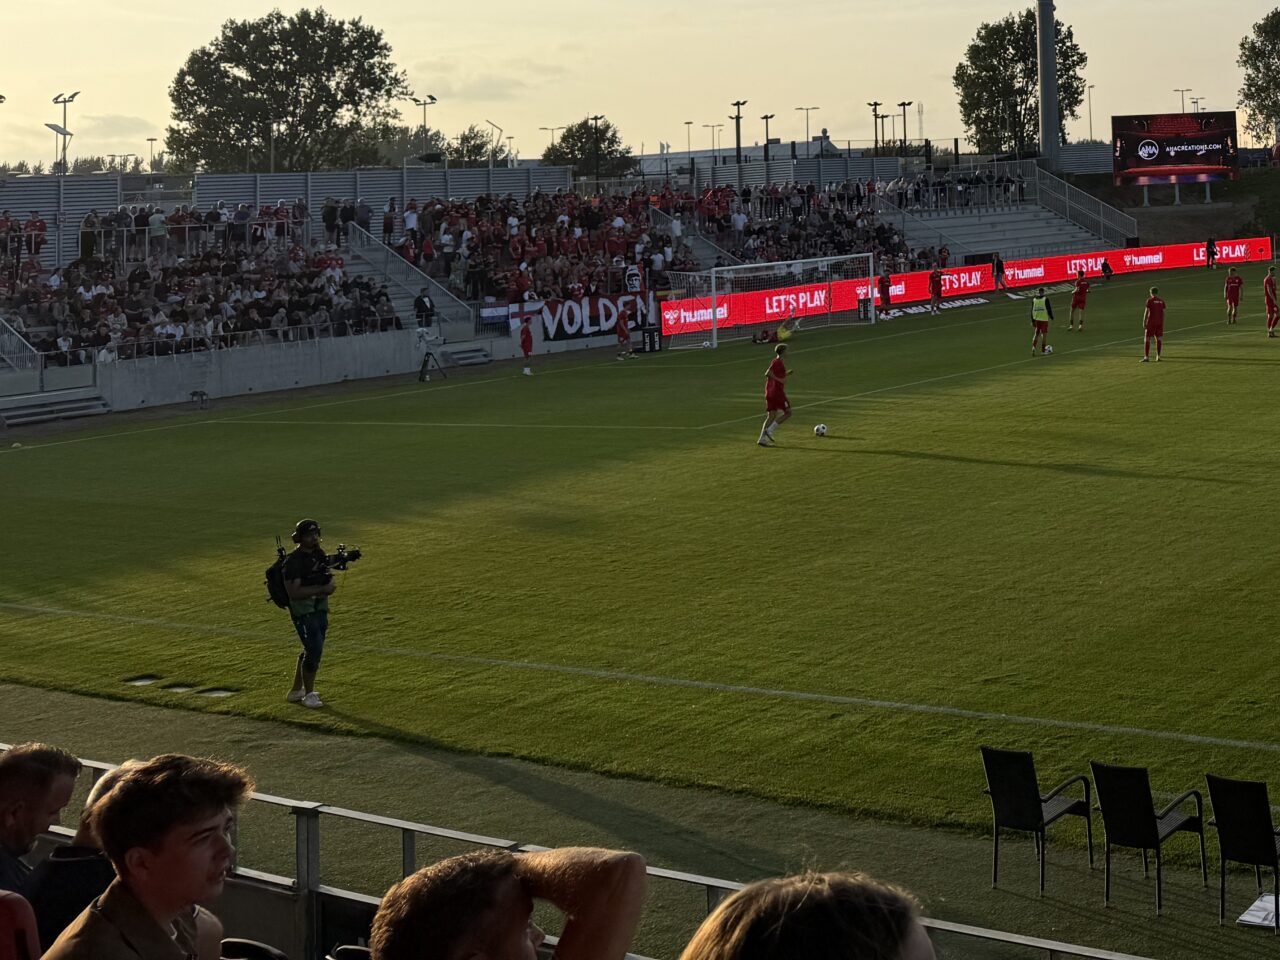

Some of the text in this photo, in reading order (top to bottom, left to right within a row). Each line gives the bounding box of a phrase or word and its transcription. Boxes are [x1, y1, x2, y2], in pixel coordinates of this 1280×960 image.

[1132, 252, 1163, 266] hummel
[1222, 244, 1246, 259] PLAY
[960, 271, 982, 288] PLAY
[1014, 265, 1045, 280] hummel
[800, 289, 826, 309] PLAY
[542, 290, 656, 339] VOLDEN
